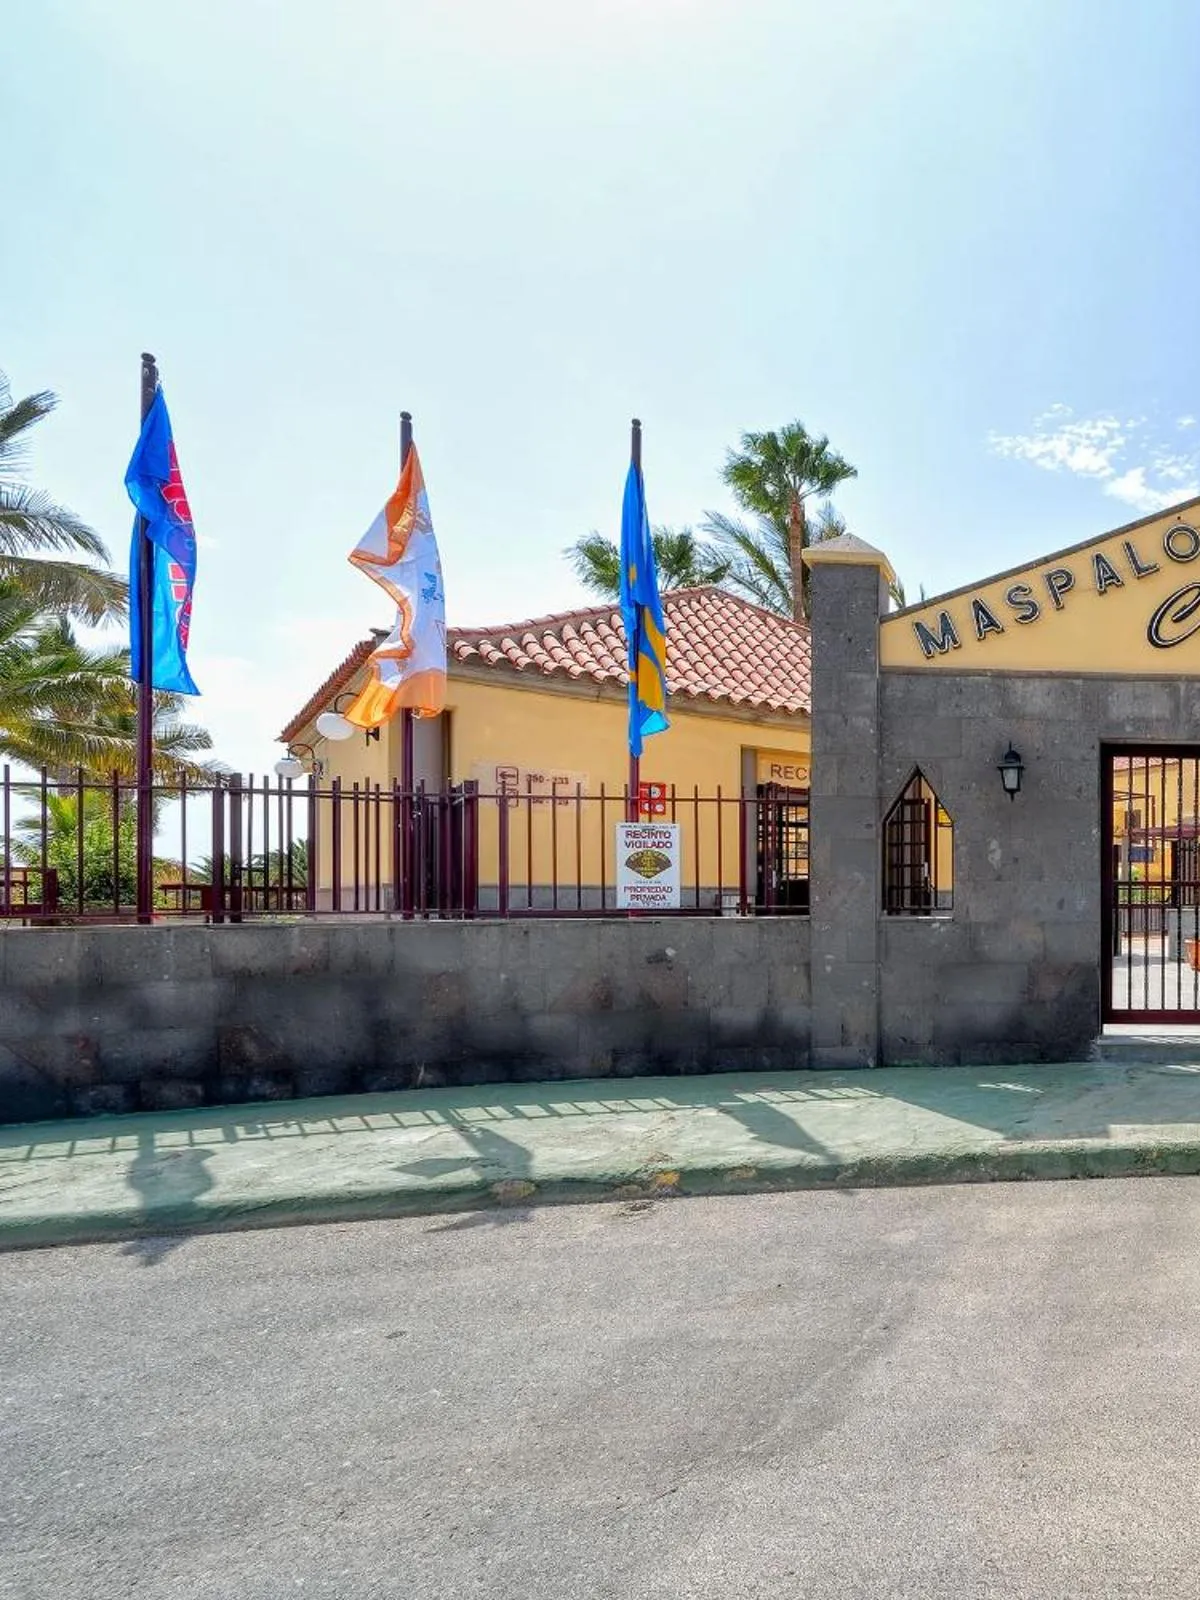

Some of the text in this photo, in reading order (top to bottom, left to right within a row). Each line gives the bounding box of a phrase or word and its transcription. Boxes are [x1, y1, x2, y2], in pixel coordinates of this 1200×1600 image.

[625, 830, 671, 839] RECINTO
[624, 840, 673, 849] VIGILADO
[624, 886, 673, 894] PROPIEDAD
[630, 894, 666, 902] PRIVADA
